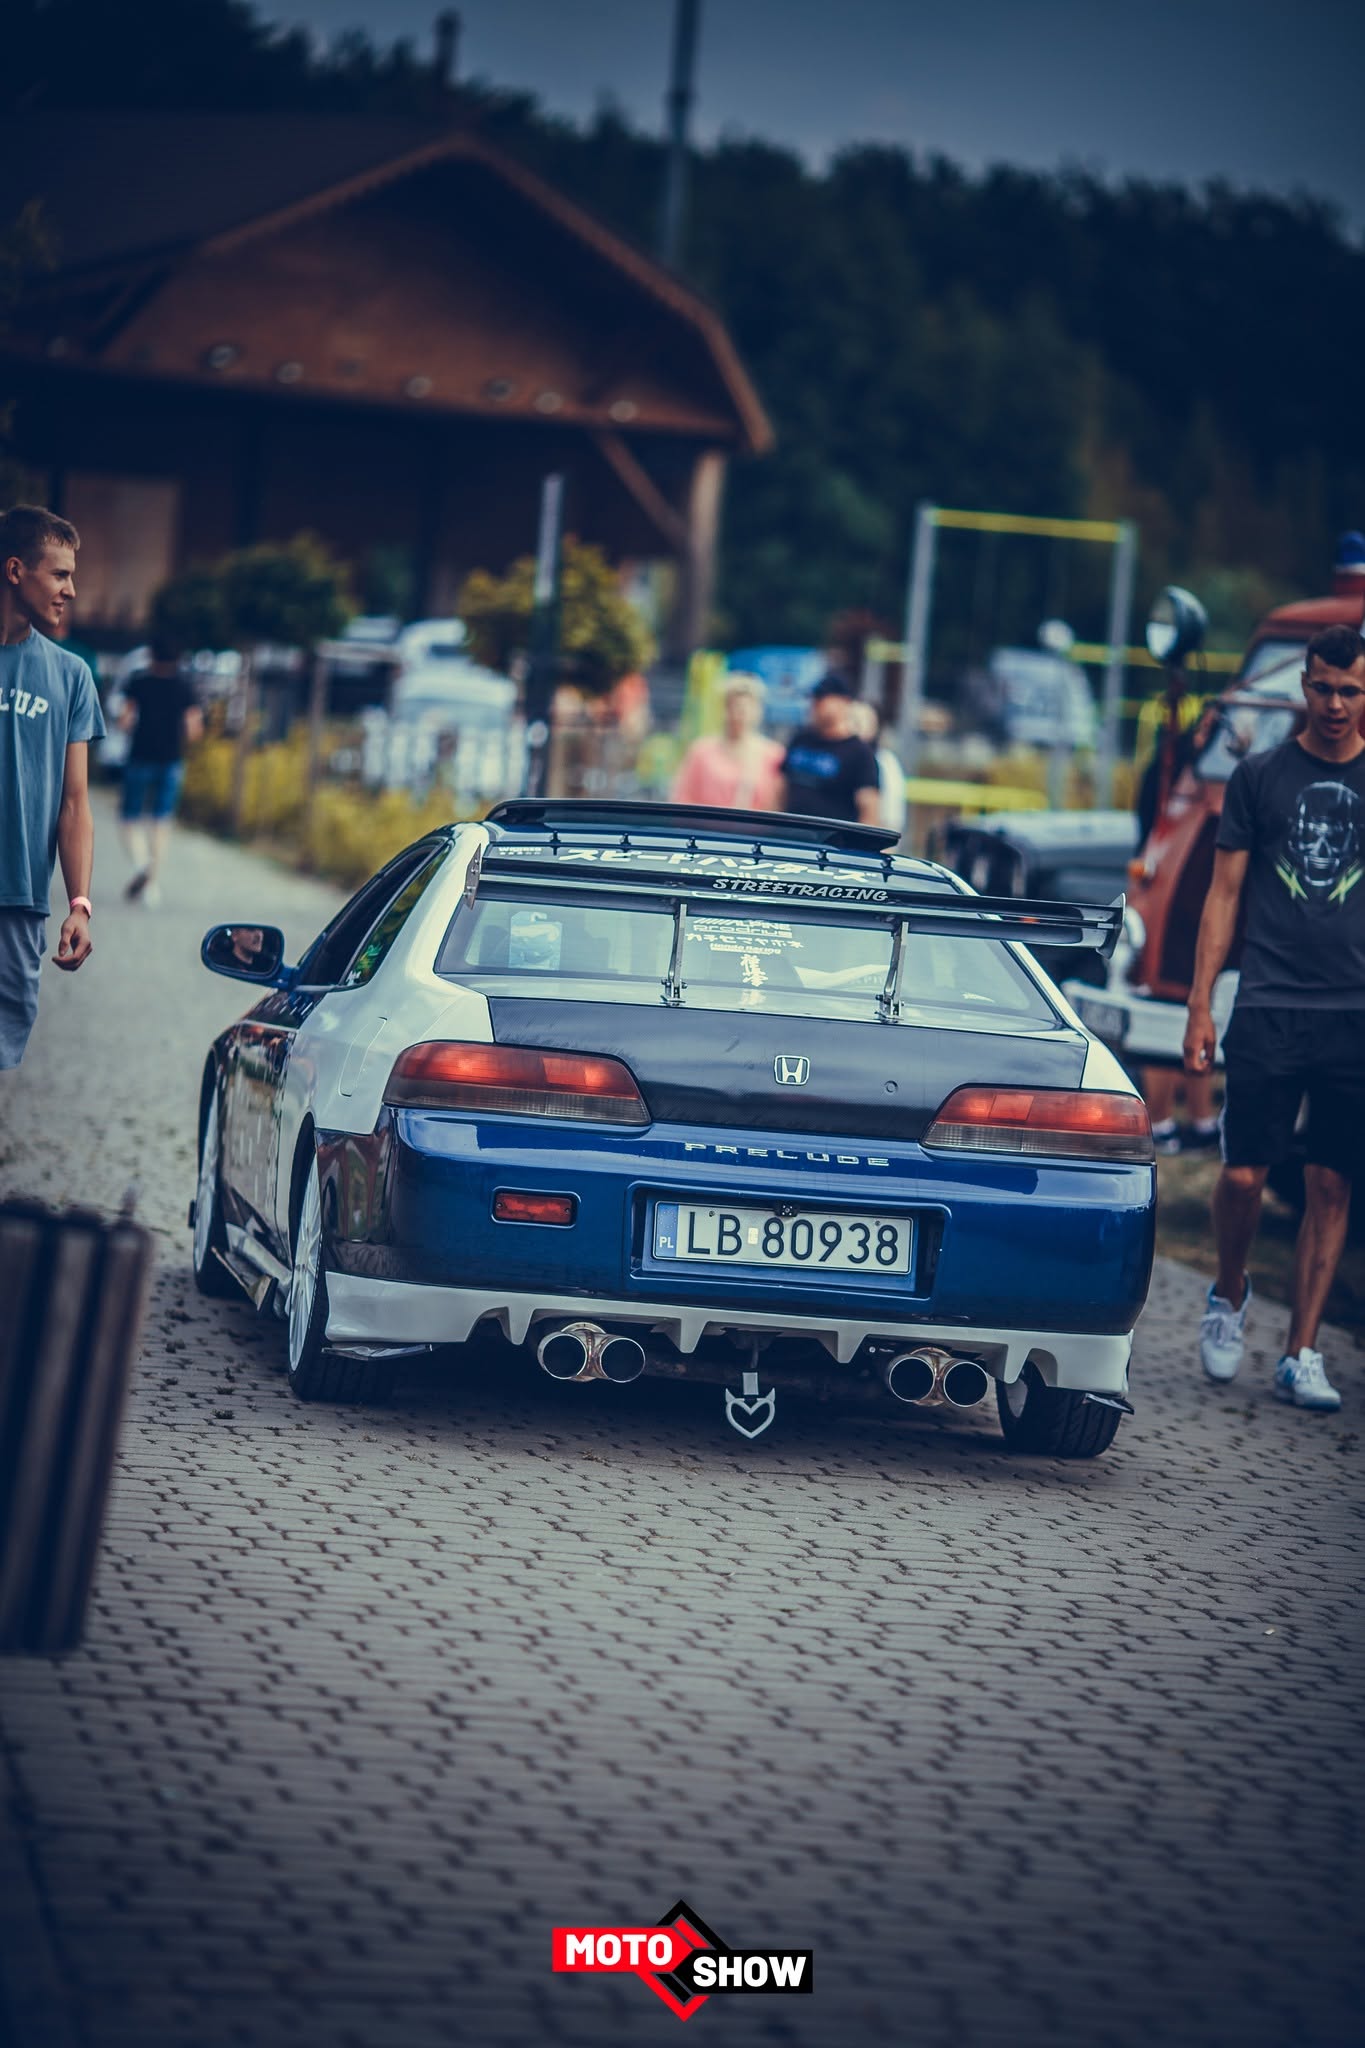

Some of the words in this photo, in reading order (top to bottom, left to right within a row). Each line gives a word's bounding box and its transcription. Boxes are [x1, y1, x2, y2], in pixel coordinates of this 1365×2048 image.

[712, 878, 889, 902] STREETRACING
[684, 1142, 890, 1167] PRELUDE
[658, 1236, 674, 1249] PL
[687, 1211, 743, 1256] LB
[762, 1216, 899, 1266] 80938
